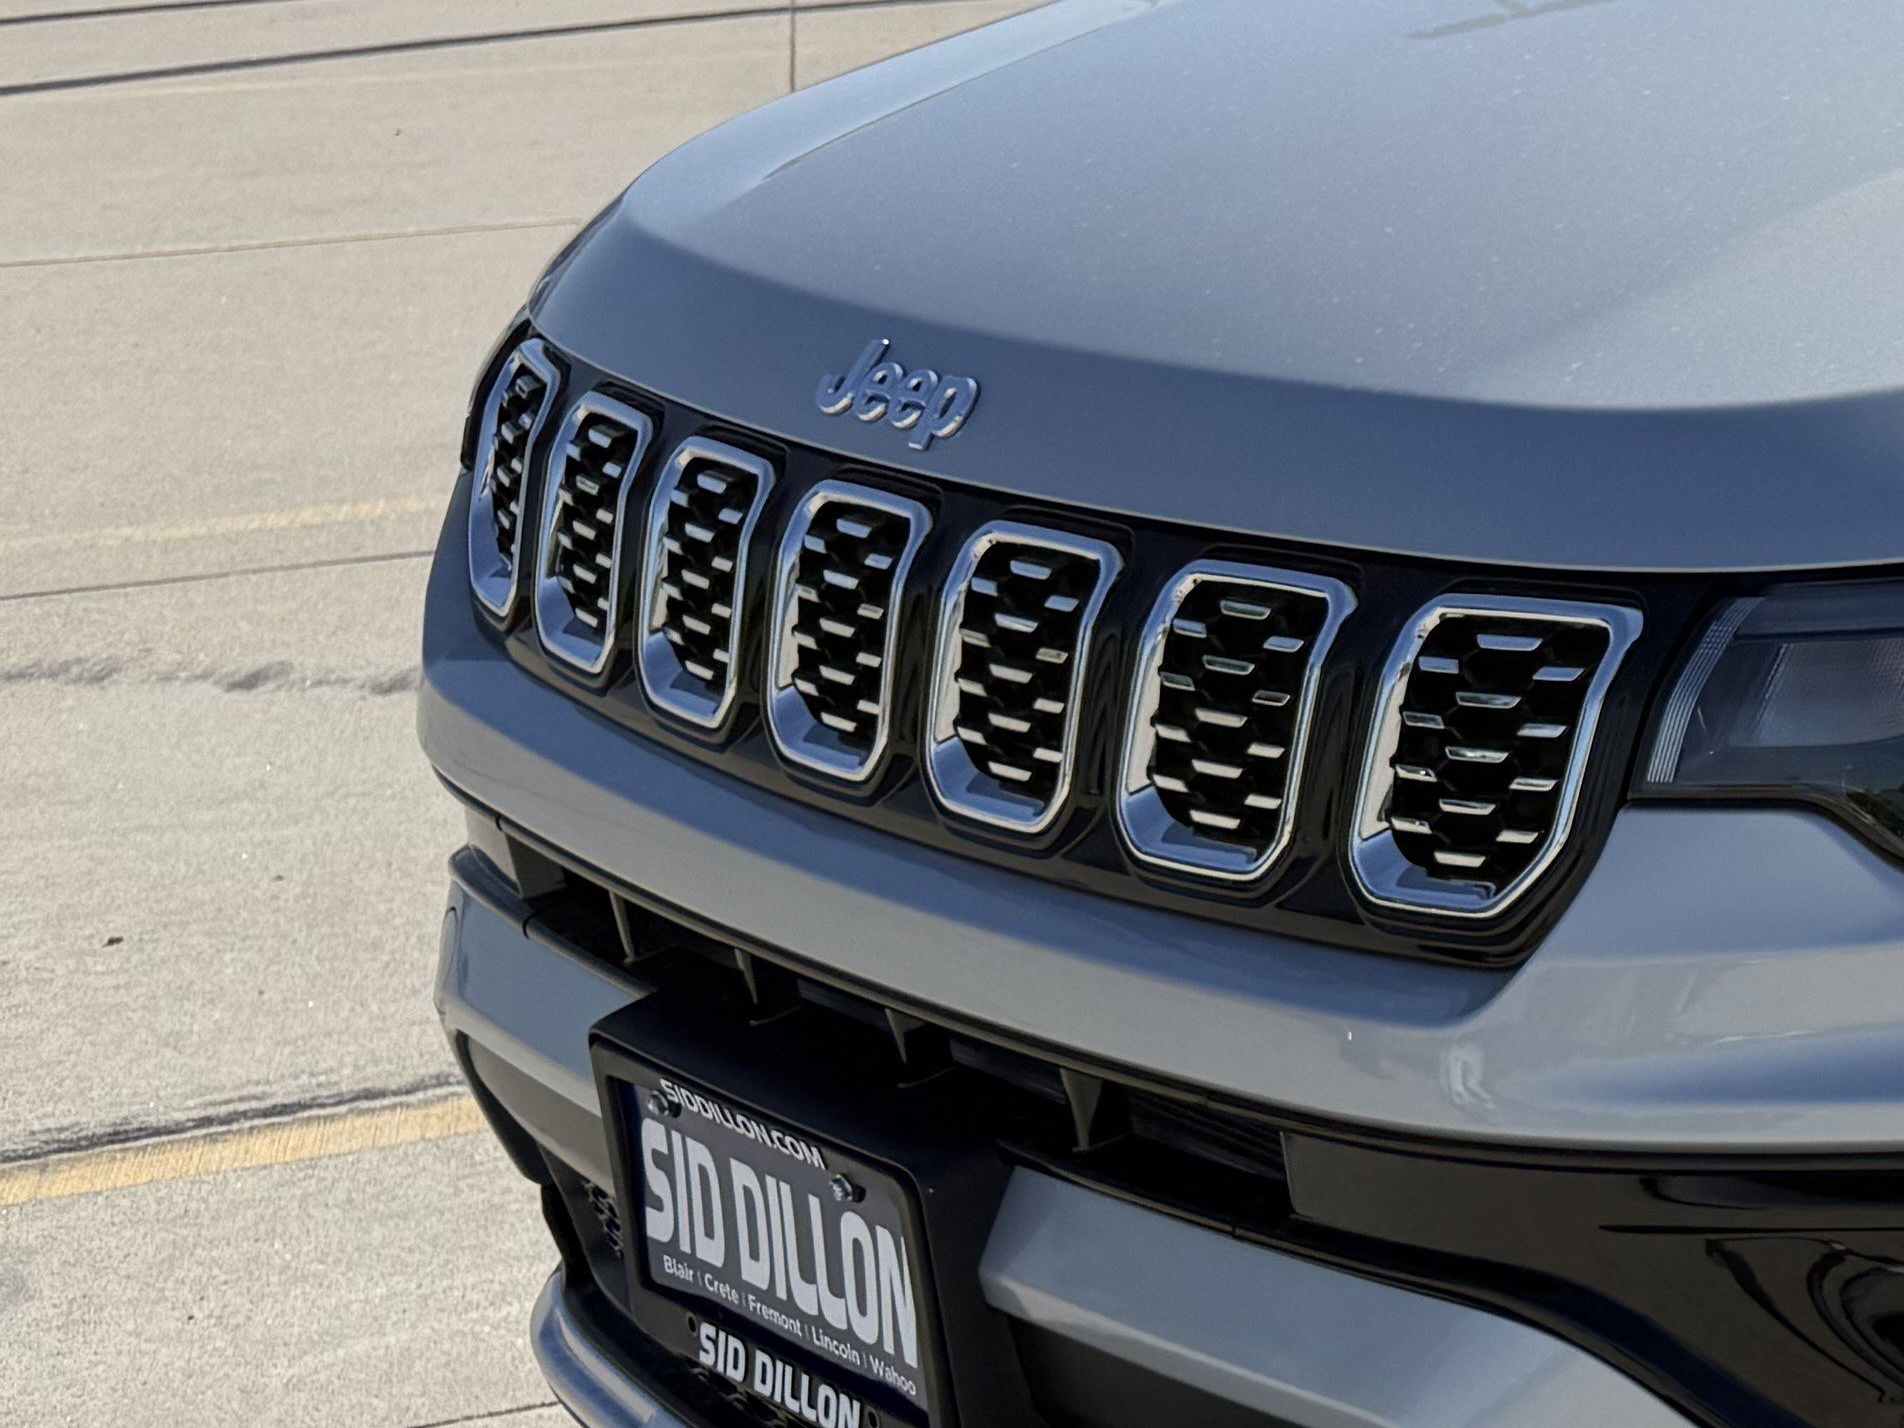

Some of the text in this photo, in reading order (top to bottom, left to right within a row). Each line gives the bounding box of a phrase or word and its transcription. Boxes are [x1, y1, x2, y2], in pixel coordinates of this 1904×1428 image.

[816, 338, 982, 450] Jeep
[660, 1078, 826, 1170] SIDDILLON.COM
[641, 1117, 918, 1369] SID DILLON
[663, 1254, 917, 1396] Blair Crete Fremont Lincoln Wahoo
[700, 1322, 746, 1383] SID
